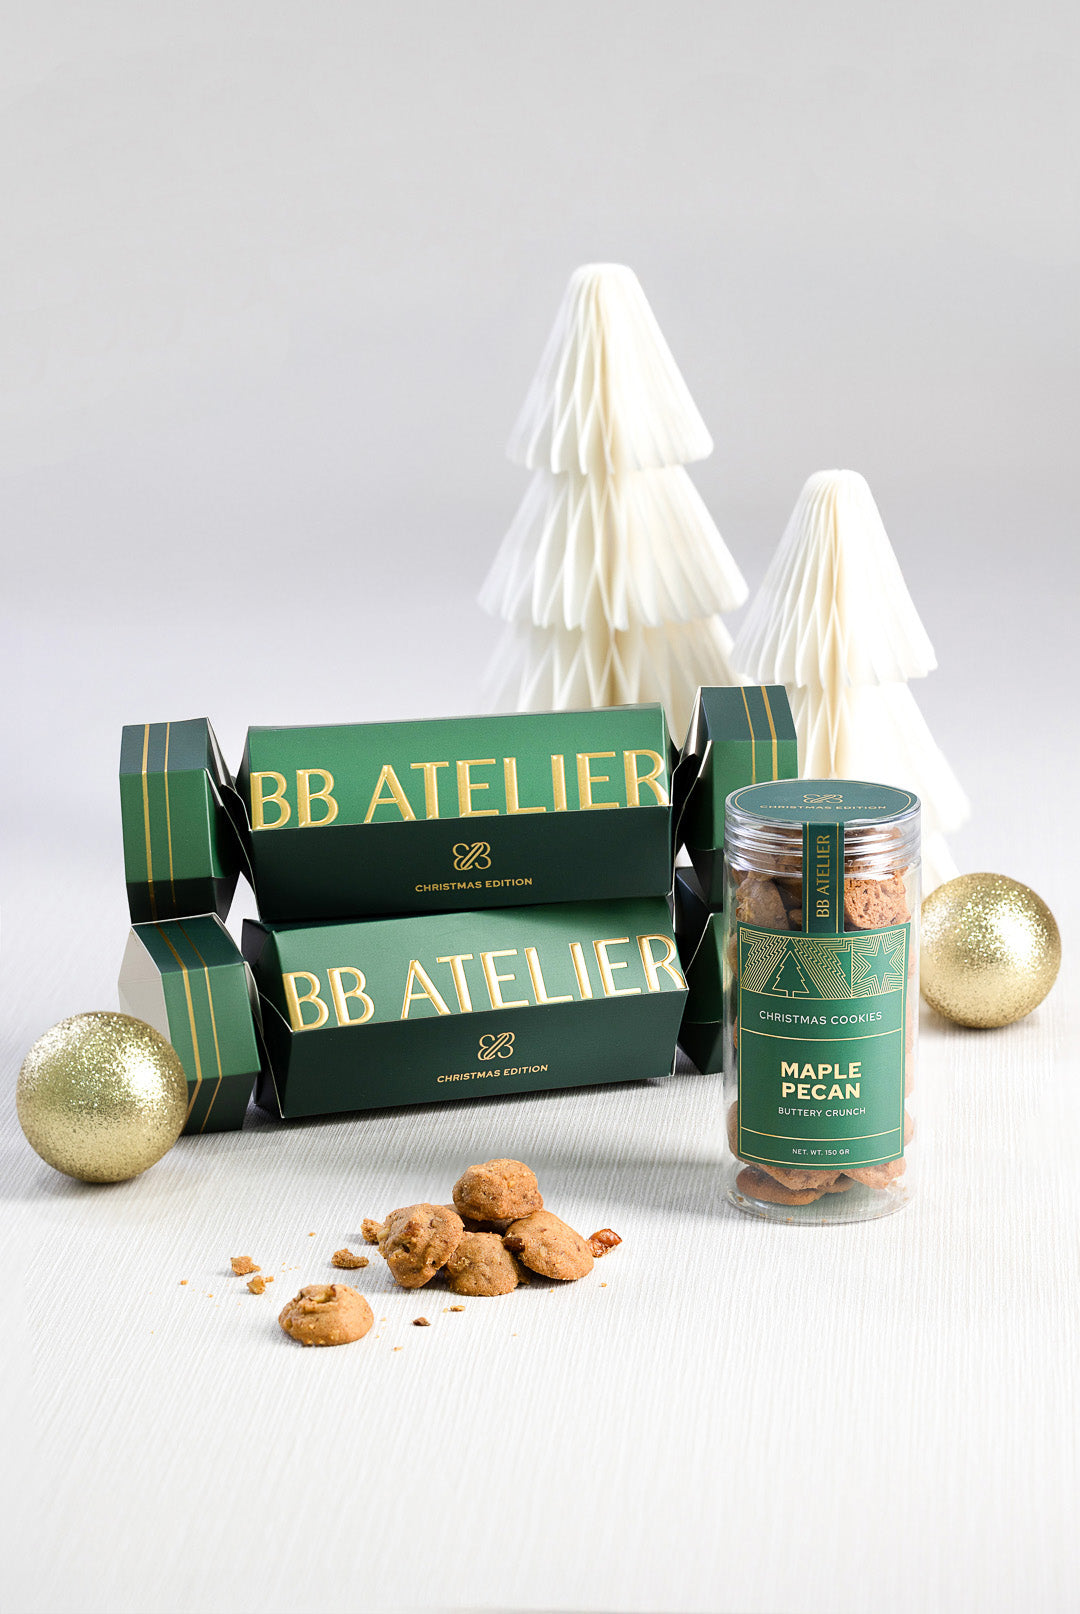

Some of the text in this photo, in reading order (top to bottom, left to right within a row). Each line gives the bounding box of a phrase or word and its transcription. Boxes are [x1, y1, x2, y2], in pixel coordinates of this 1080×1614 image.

[250, 749, 671, 831] BB ATELIER
[414, 877, 533, 893] CHRISTMAS EDITION
[816, 834, 830, 918] BB ATELIER
[282, 933, 688, 1032] BB ATELIER
[759, 1010, 883, 1025] CHRISTMAS COOKIES
[436, 1063, 549, 1083] CHRISTMAS EDITION
[780, 1061, 862, 1080] MAPLE
[781, 1082, 861, 1100] PECAN
[778, 1106, 866, 1117] BUTTERY CRUNCH
[792, 1148, 809, 1156] NET.
[839, 1148, 850, 1156] GR
